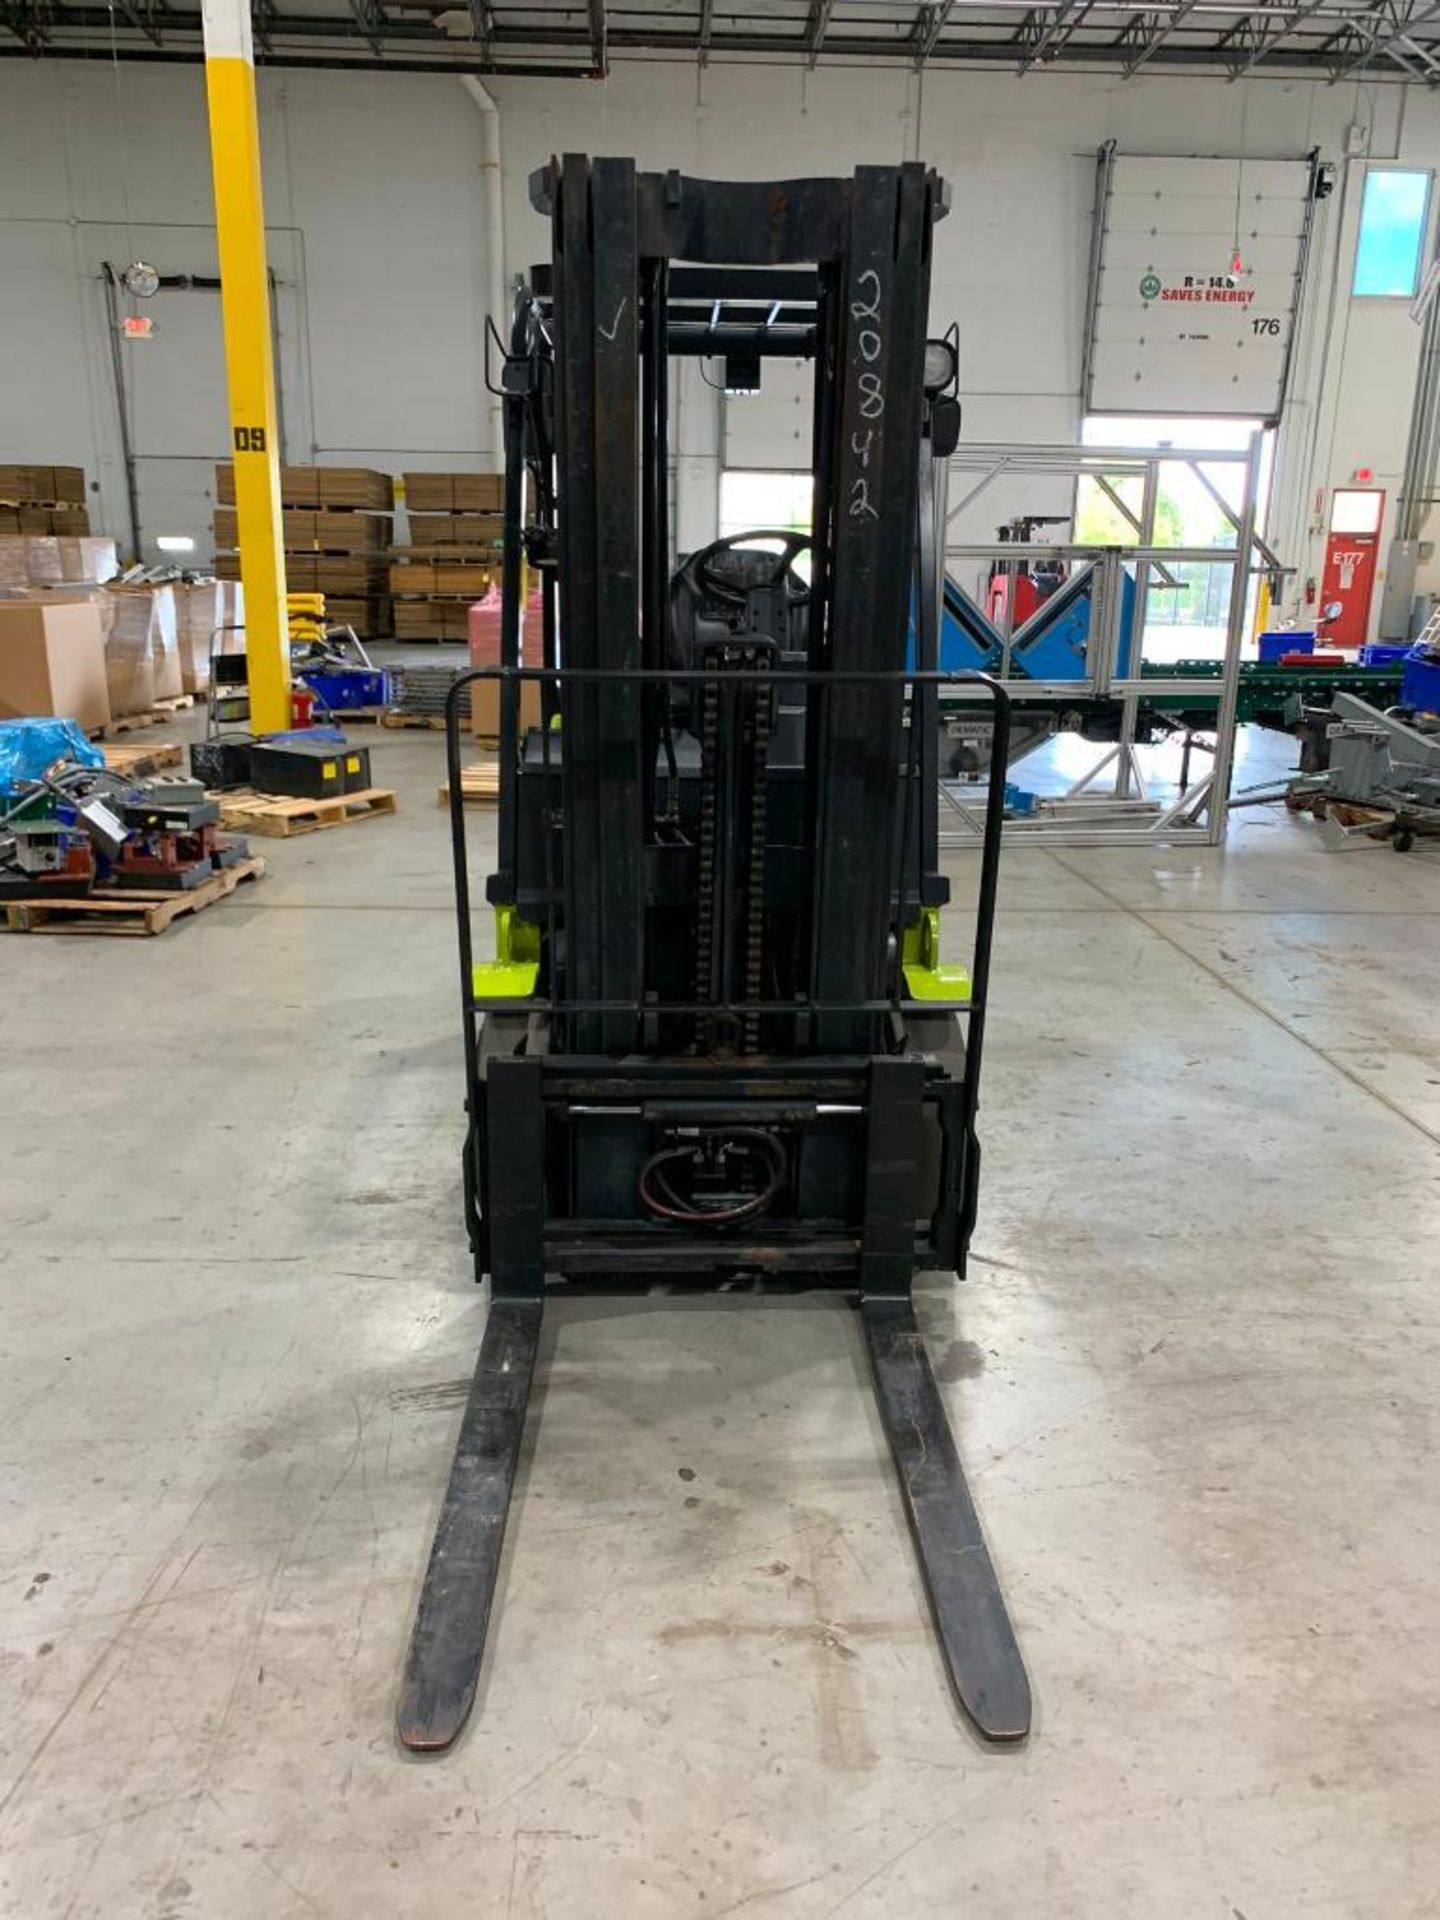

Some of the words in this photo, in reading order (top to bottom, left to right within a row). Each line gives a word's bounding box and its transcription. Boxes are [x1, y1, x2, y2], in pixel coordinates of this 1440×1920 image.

[1184, 276, 1194, 288] R
[1161, 288, 1202, 301] SAVES
[1205, 289, 1255, 303] ENERGY
[1252, 318, 1280, 336] 176
[850, 269, 885, 519] 20842
